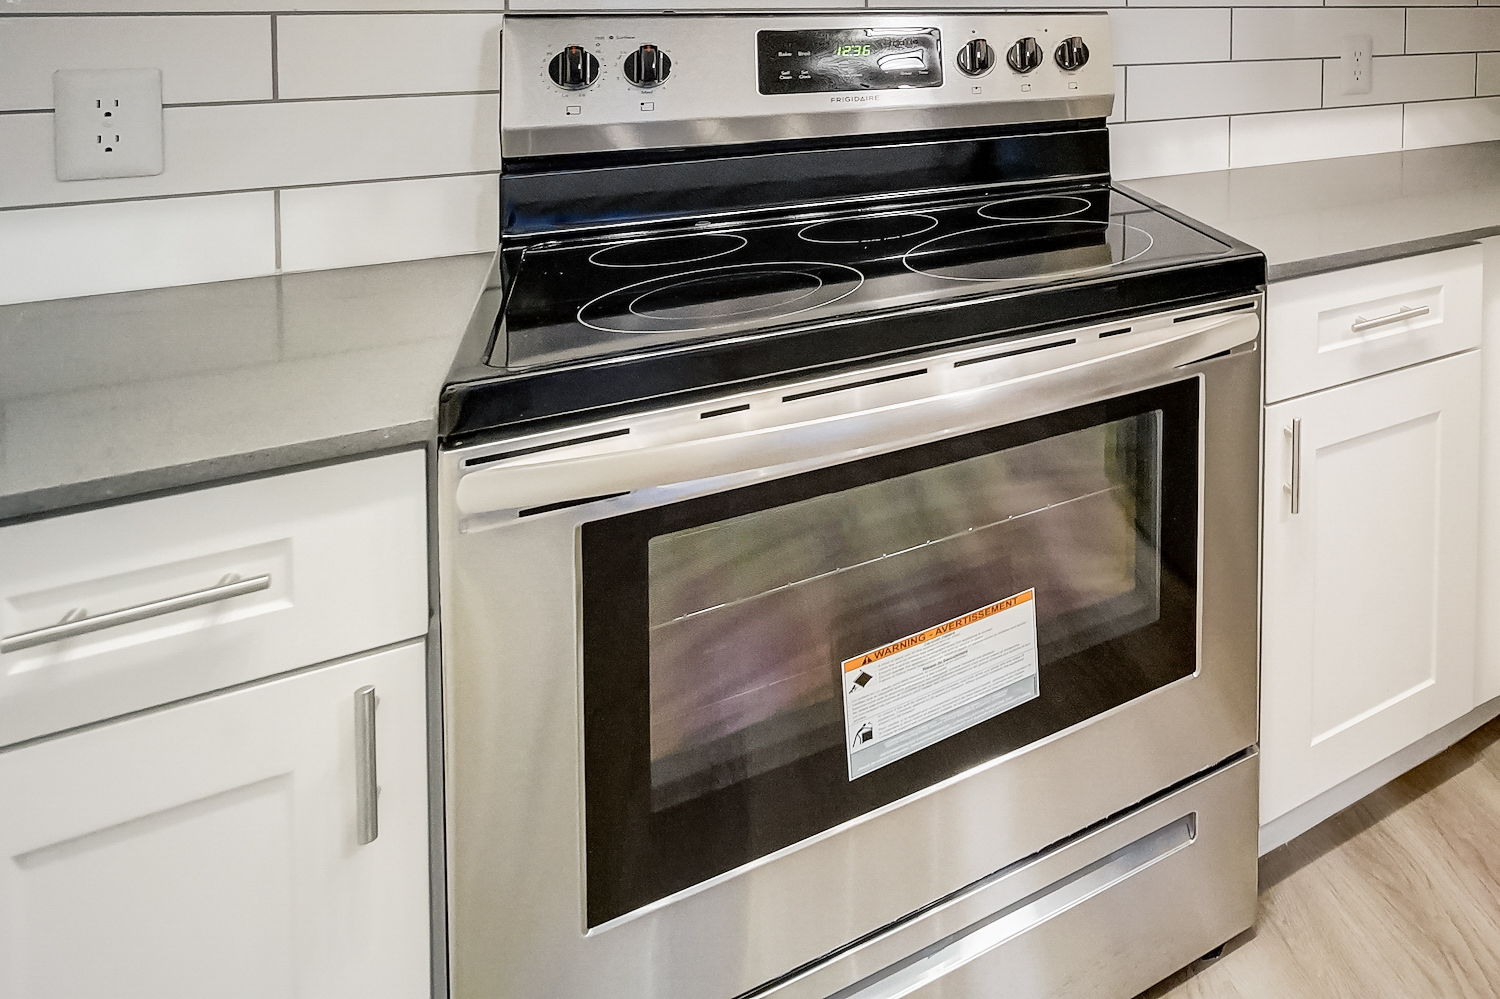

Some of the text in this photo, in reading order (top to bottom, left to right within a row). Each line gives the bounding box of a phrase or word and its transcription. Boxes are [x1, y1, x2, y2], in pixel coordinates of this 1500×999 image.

[830, 95, 880, 103] FRIGIDAIRE
[874, 633, 926, 659] WARNING
[935, 597, 1019, 636] AVERTISSEMENT
